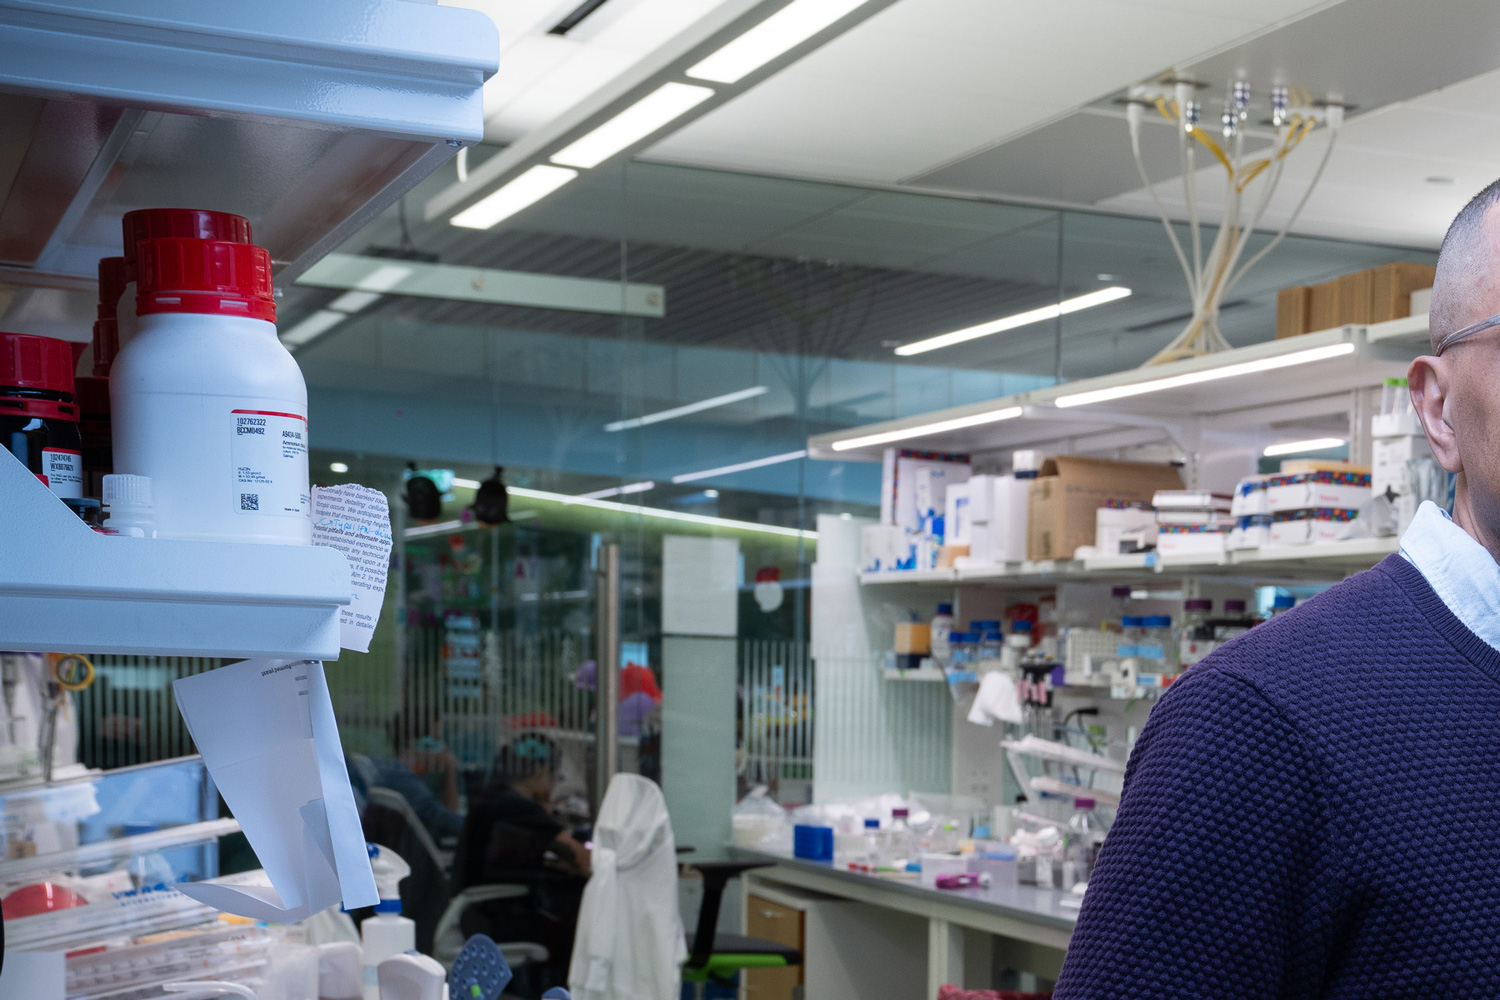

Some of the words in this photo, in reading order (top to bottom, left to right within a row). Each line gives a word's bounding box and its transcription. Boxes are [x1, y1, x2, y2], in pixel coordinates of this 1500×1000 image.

[347, 506, 357, 514] We
[357, 509, 381, 520] anticipate
[367, 503, 388, 513] cellular
[341, 514, 361, 523] improve
[361, 517, 373, 526] lung
[328, 526, 344, 535] pitfalls
[344, 529, 355, 537] and
[355, 531, 379, 543] alternate
[330, 535, 356, 546] established
[356, 540, 384, 552] experience
[346, 554, 362, 563] based
[362, 558, 376, 567] upon
[361, 550, 386, 560] technical
[364, 566, 386, 577] possible
[373, 576, 386, 584] that
[355, 612, 372, 621] results
